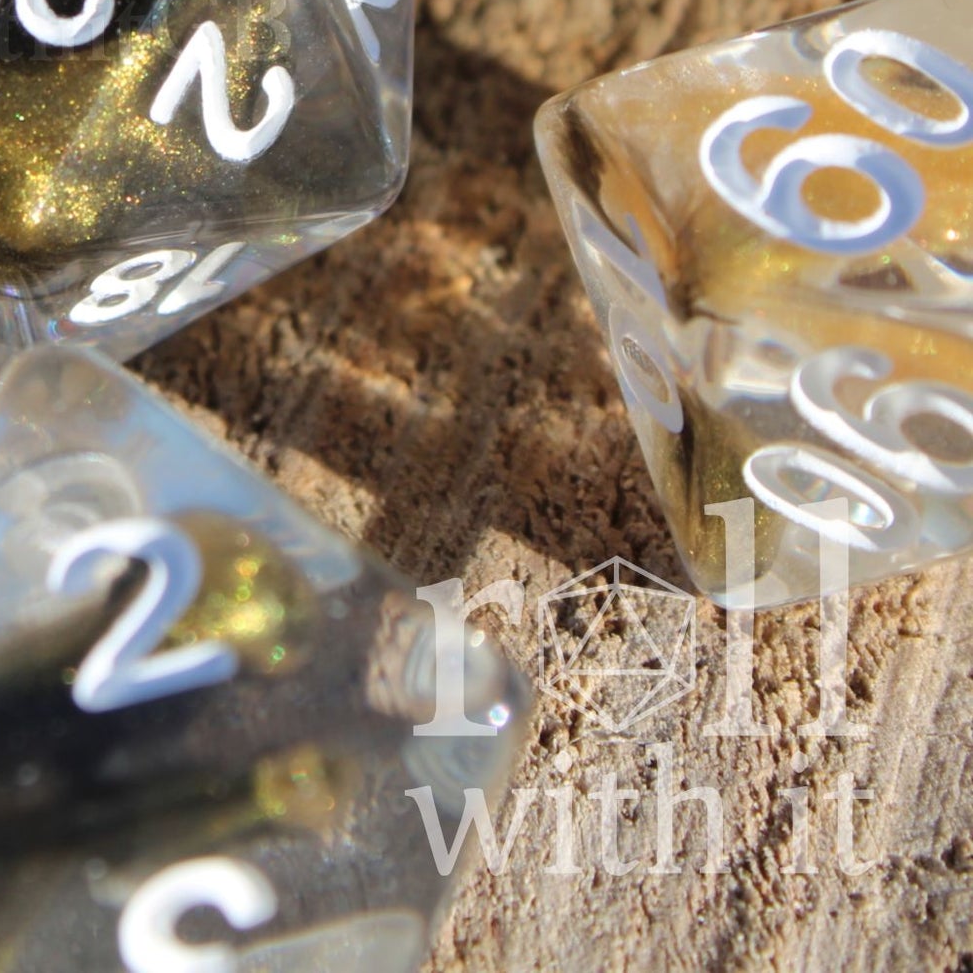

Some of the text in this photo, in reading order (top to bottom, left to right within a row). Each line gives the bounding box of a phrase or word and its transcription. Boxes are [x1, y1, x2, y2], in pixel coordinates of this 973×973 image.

[149, 20, 296, 163] 2
[69, 241, 247, 324] 18
[45, 515, 240, 714] 2
